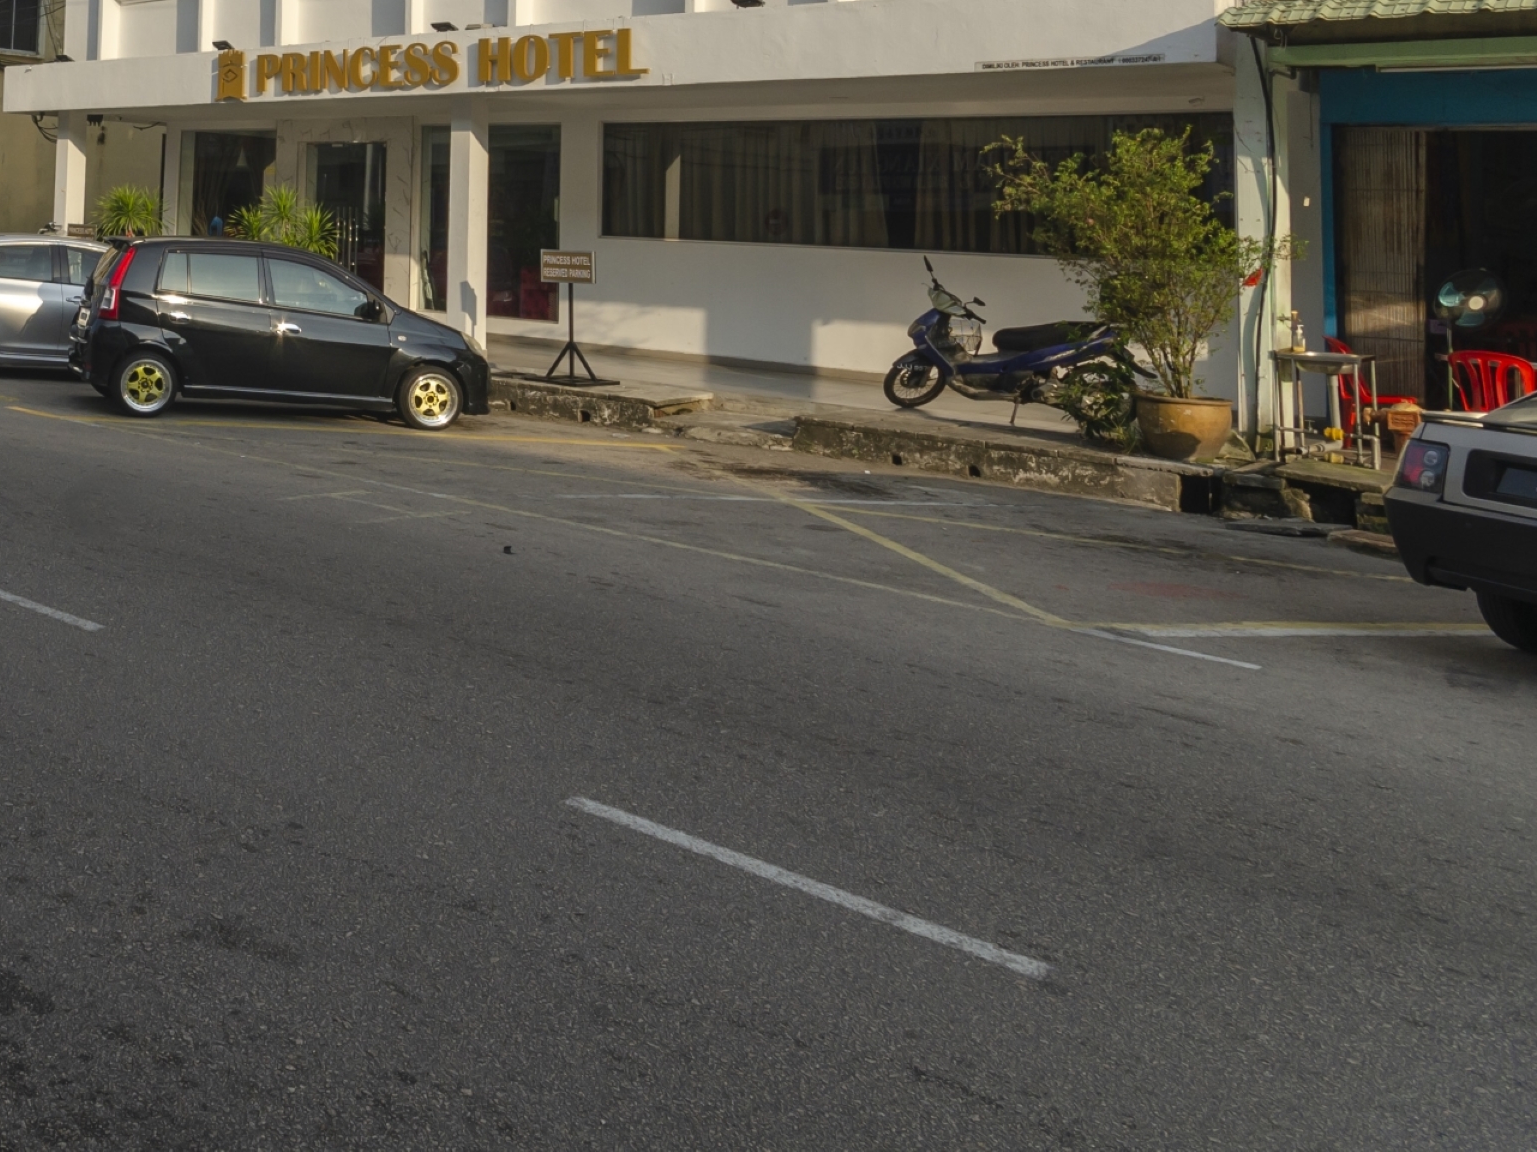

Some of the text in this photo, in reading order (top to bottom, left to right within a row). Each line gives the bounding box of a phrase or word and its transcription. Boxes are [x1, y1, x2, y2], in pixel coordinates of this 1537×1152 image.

[256, 27, 650, 94] PRINCESS HOTEL
[543, 255, 591, 266] PRINCESS HOTEL
